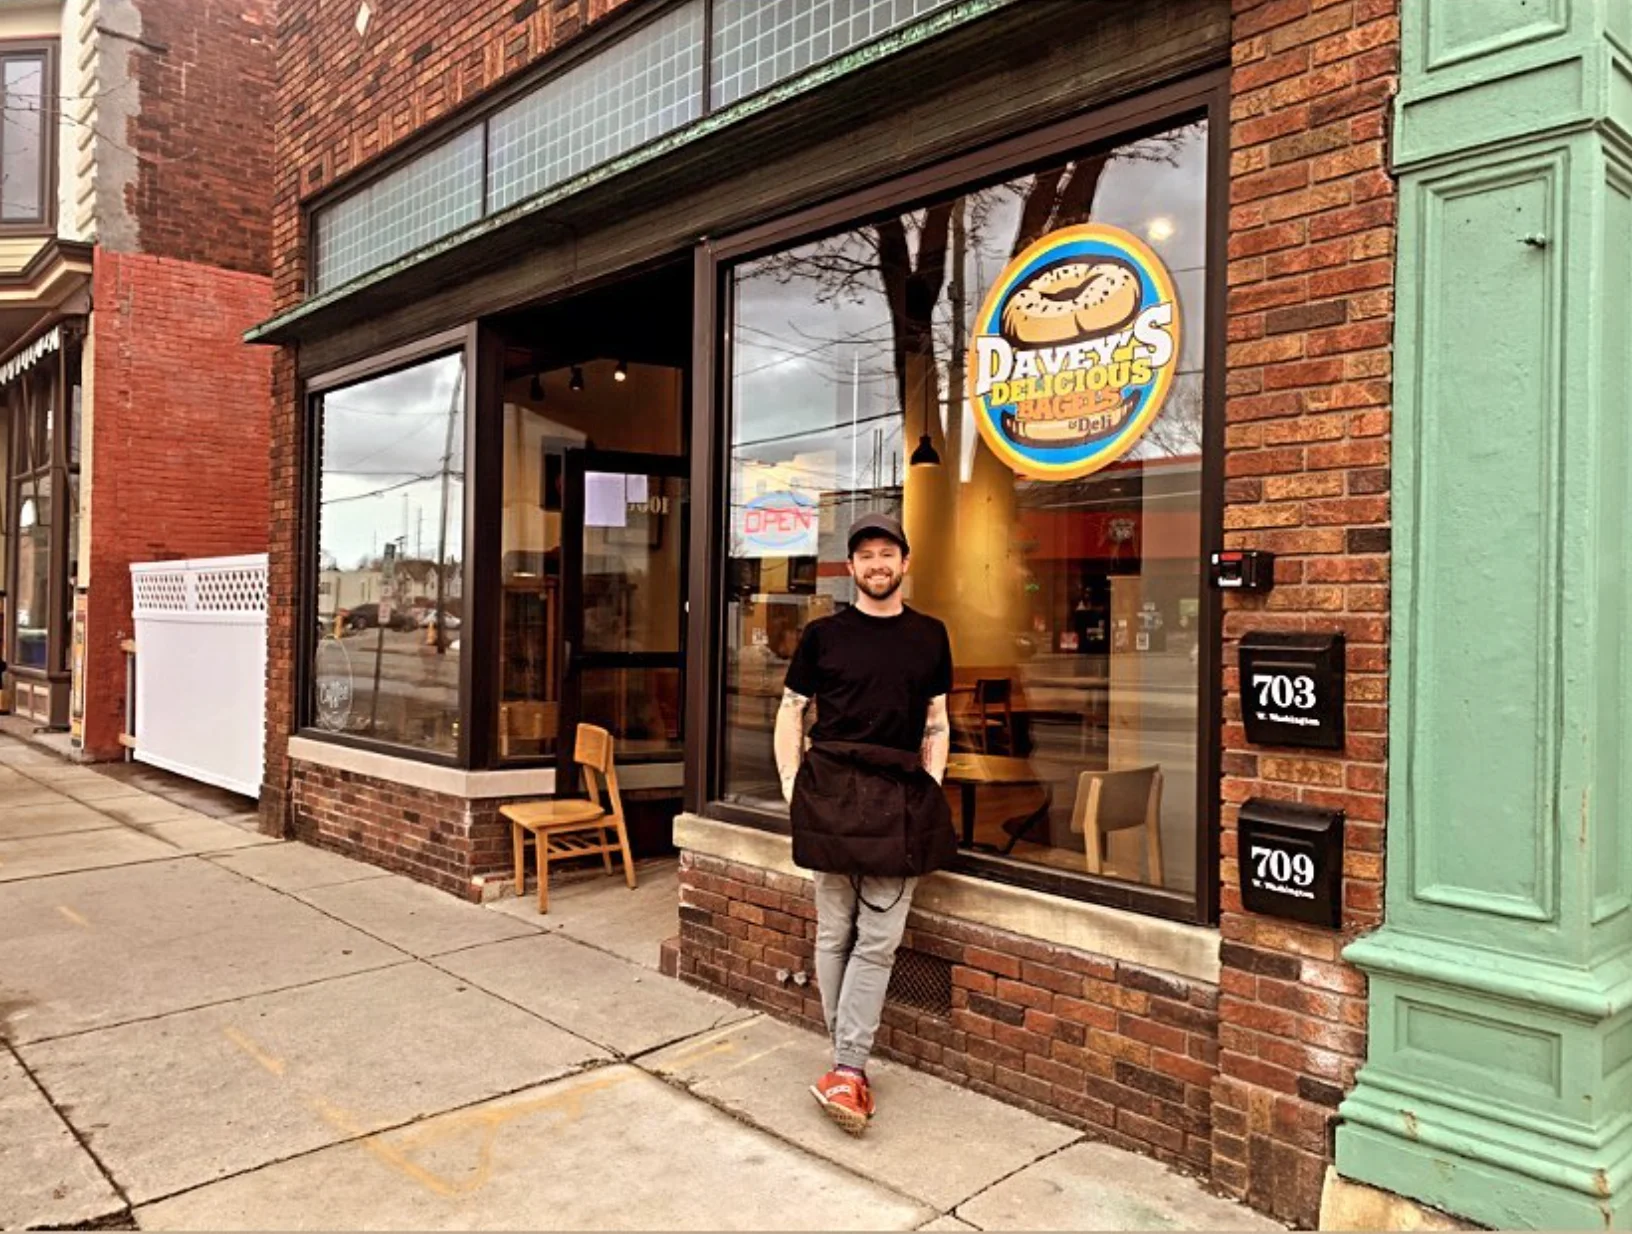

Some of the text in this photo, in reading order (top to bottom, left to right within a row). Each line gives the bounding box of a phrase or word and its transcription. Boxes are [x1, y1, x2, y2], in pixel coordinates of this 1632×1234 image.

[990, 359, 1152, 406] DELICIOUS
[1016, 387, 1123, 421] BAGELS
[744, 506, 813, 533] OPEN
[1252, 674, 1316, 709] 703
[1251, 846, 1315, 885] 709
